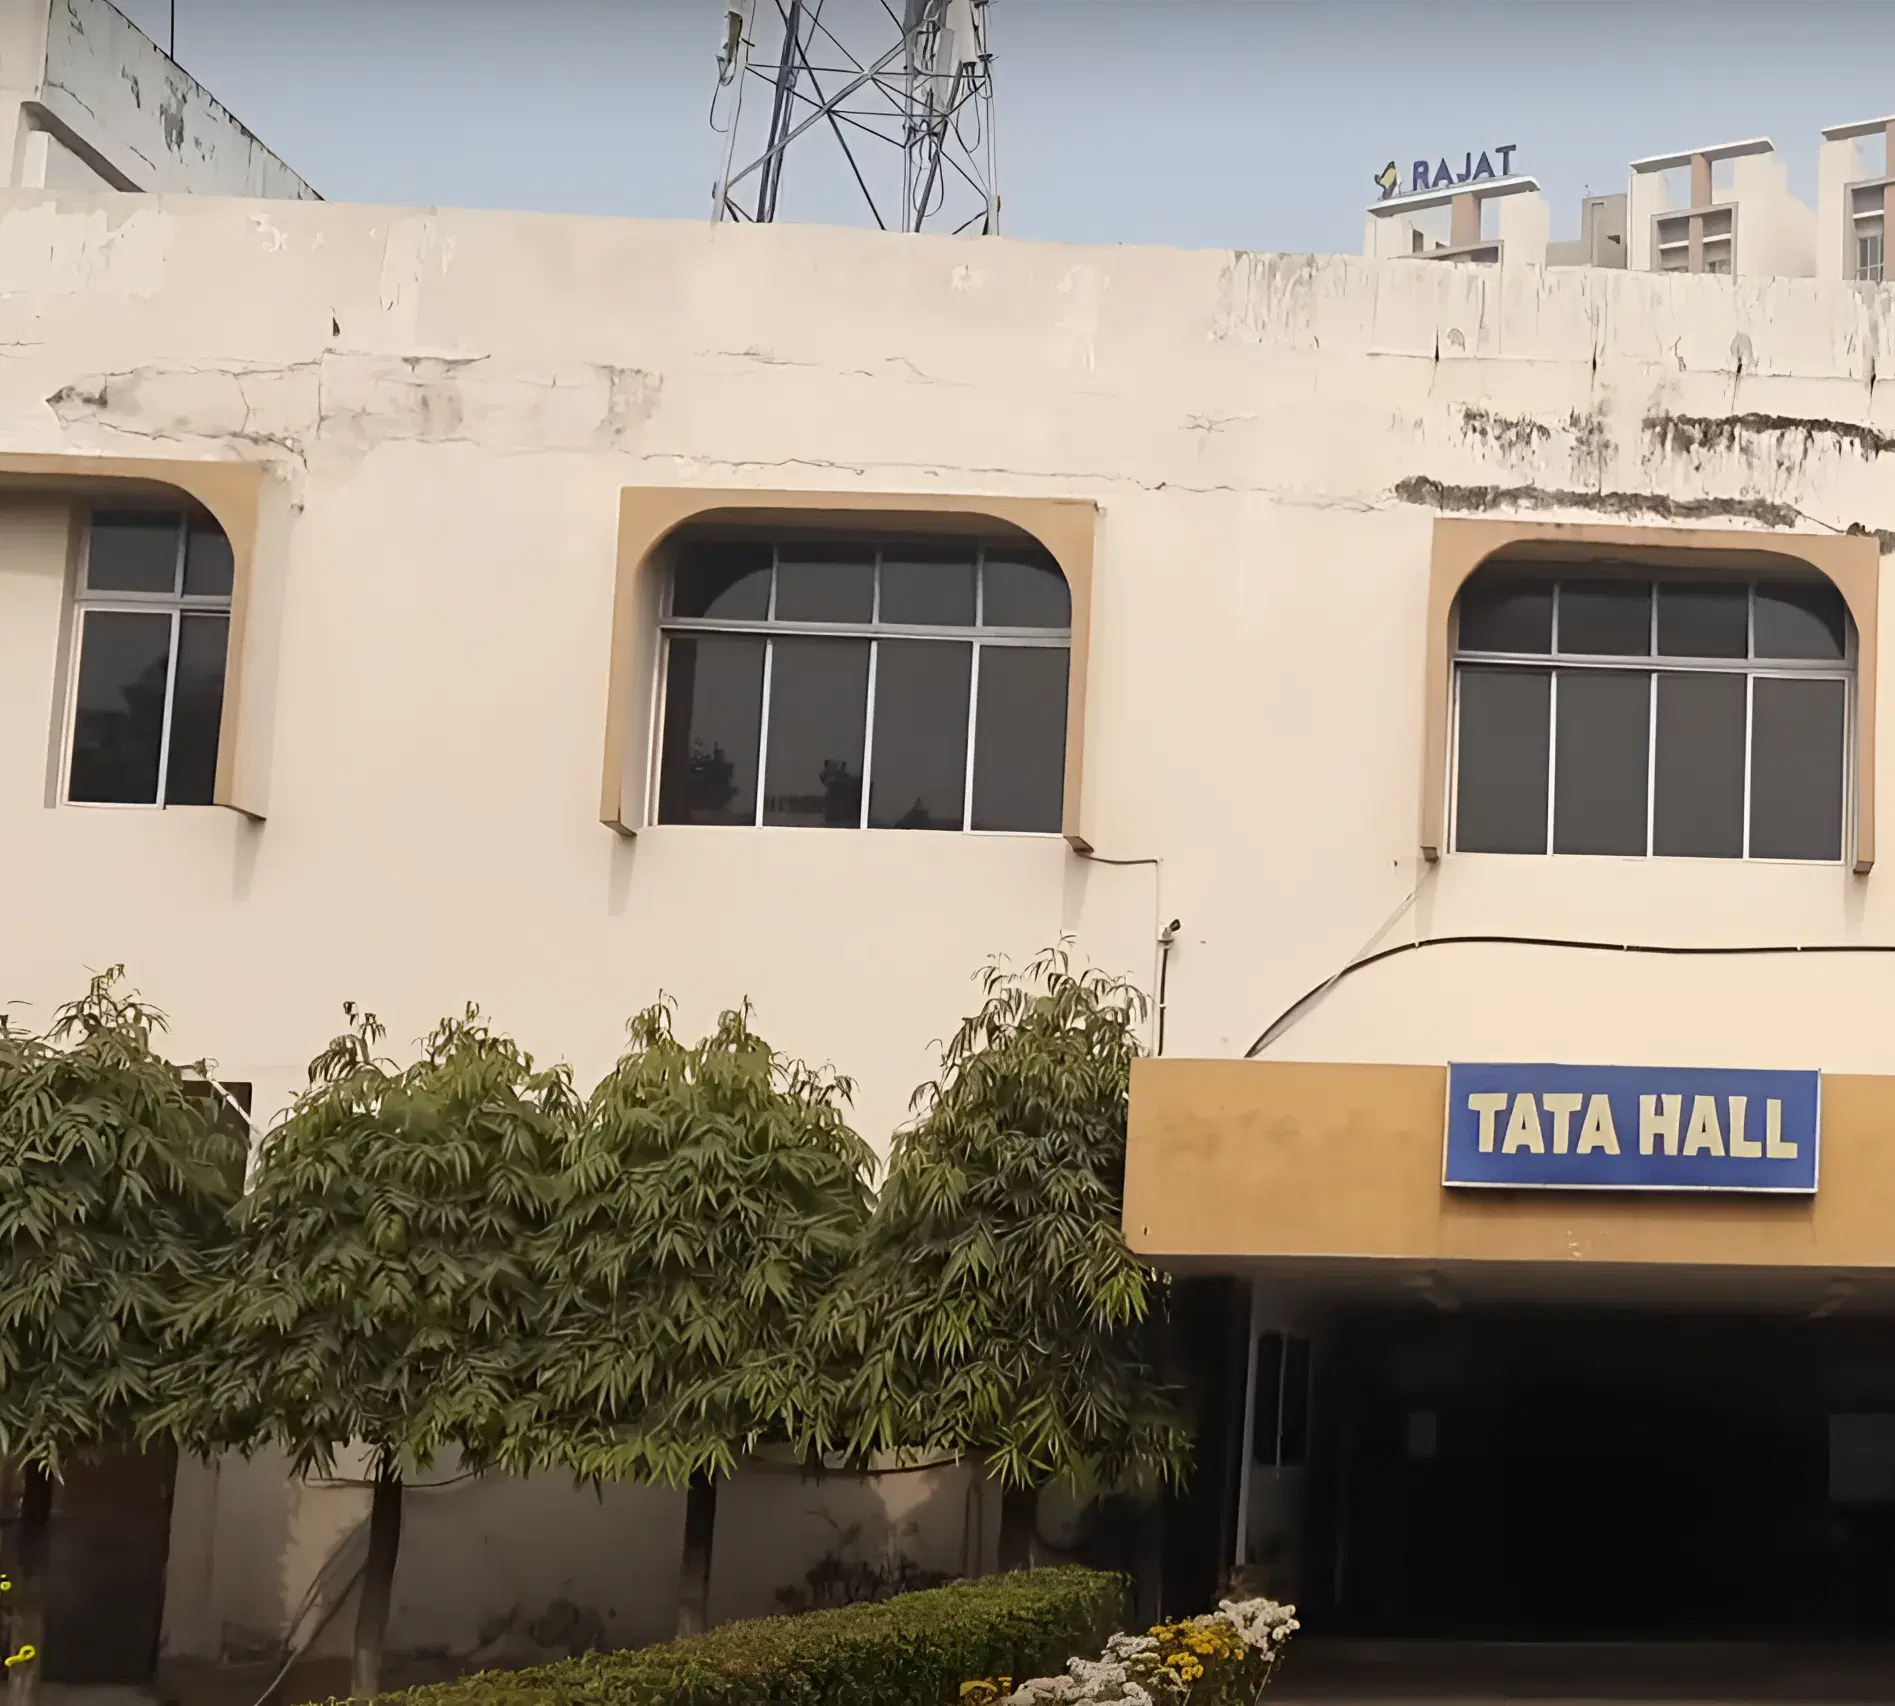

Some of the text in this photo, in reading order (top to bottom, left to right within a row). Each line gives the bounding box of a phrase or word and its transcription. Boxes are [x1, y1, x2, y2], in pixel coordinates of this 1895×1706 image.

[1412, 144, 1516, 191] RAJAT
[1468, 1092, 1798, 1159] TATA HALL
